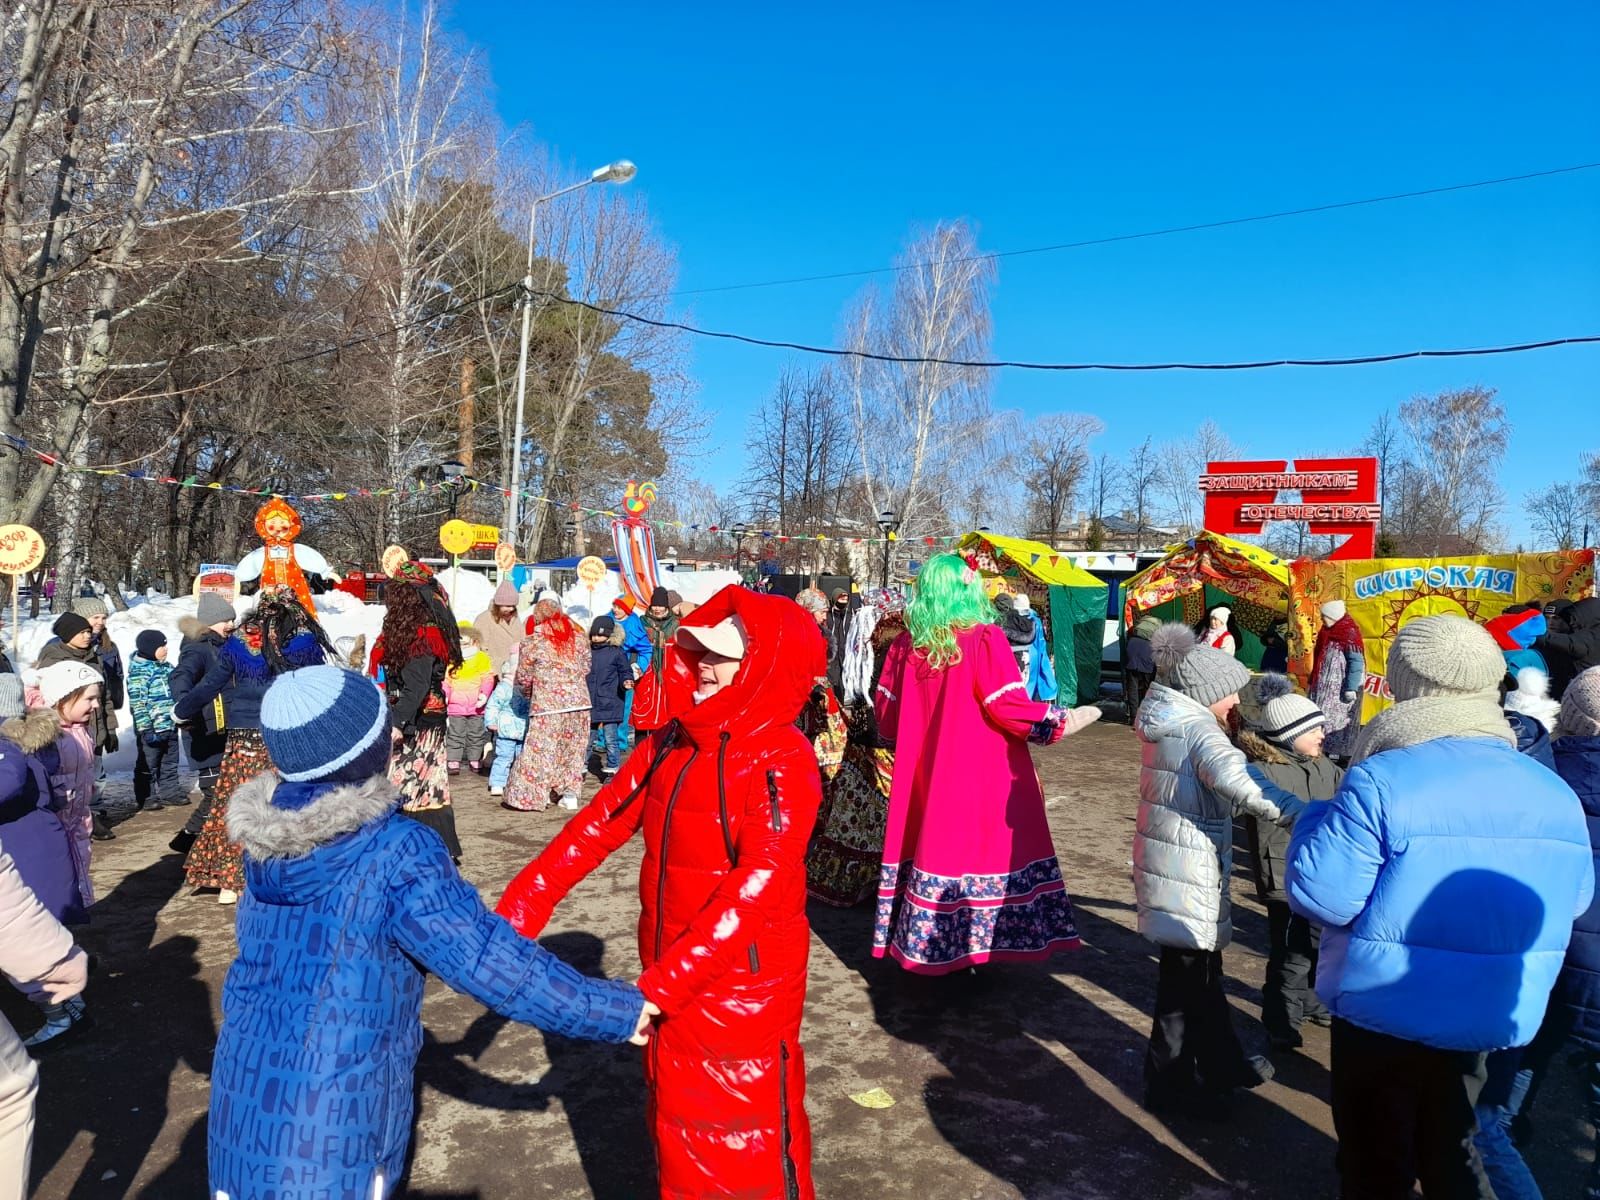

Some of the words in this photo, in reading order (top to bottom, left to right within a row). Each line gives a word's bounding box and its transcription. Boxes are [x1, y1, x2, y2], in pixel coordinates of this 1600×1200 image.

[1206, 473, 1350, 490] ЗАЩИТНИКАМ
[1247, 505, 1370, 520] ОТЕЧЕСТВА
[1355, 564, 1516, 600] ШИРОКАЯ
[246, 1161, 318, 1186] YEAH
